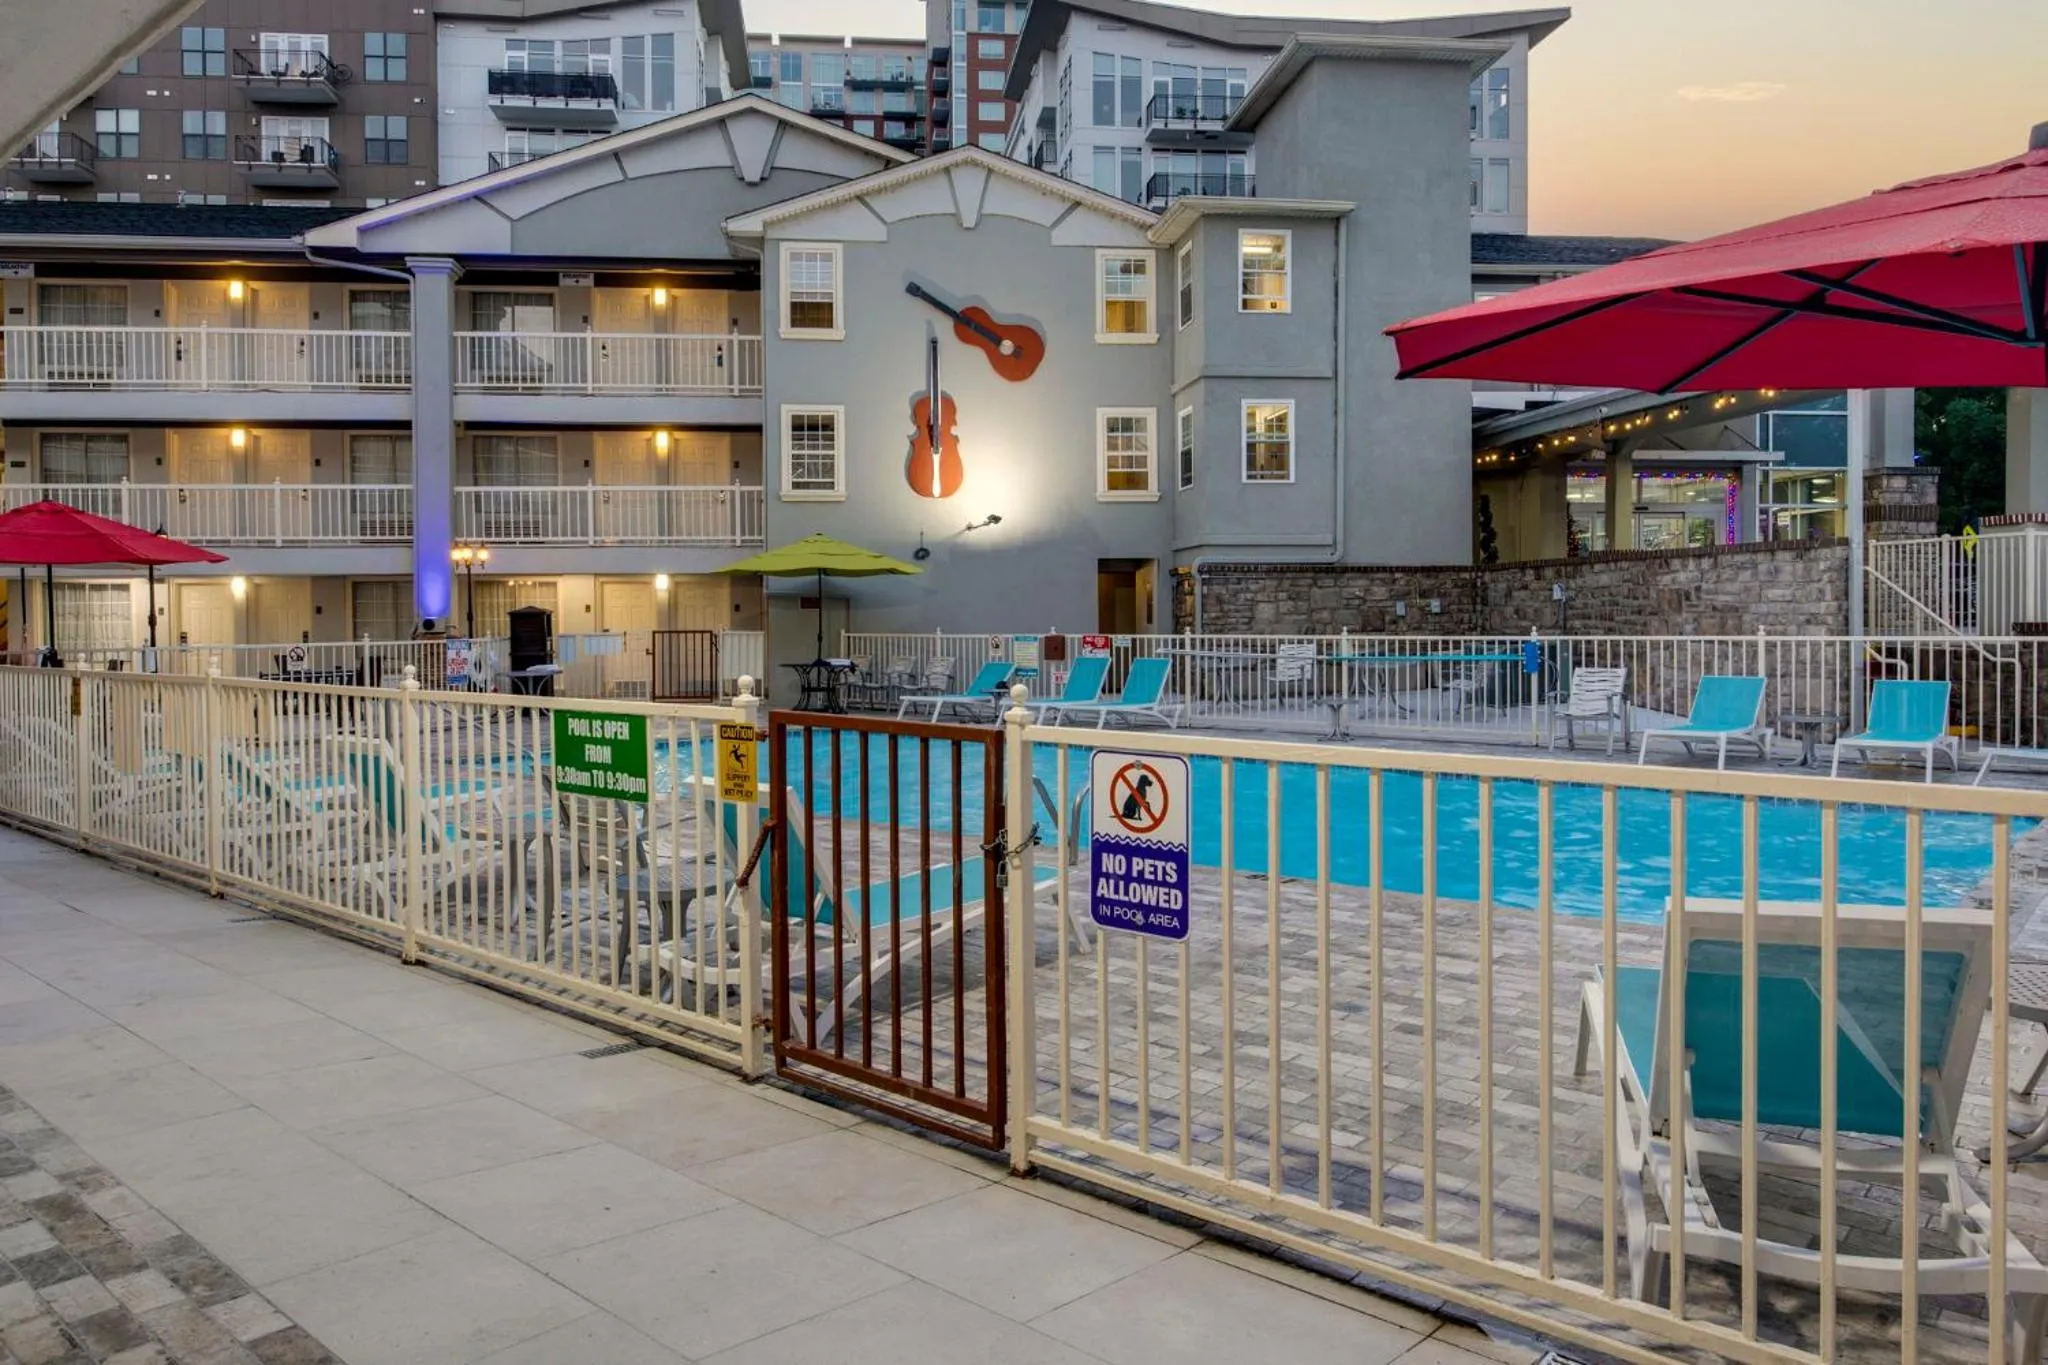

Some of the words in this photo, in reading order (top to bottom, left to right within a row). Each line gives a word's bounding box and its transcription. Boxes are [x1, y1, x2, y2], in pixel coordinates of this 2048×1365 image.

[567, 717, 592, 737] POOL
[592, 719, 603, 738] IS
[604, 720, 630, 740] OPEN
[721, 726, 753, 740] CAUTION
[584, 743, 612, 764] FROM
[592, 769, 605, 788] TO
[606, 771, 647, 794] 9:30pm
[1101, 852, 1127, 875] NO
[1131, 857, 1178, 884] PETS
[1096, 877, 1183, 911] ALLOWED
[1099, 904, 1111, 918] IN
[1148, 912, 1180, 929] AREA
